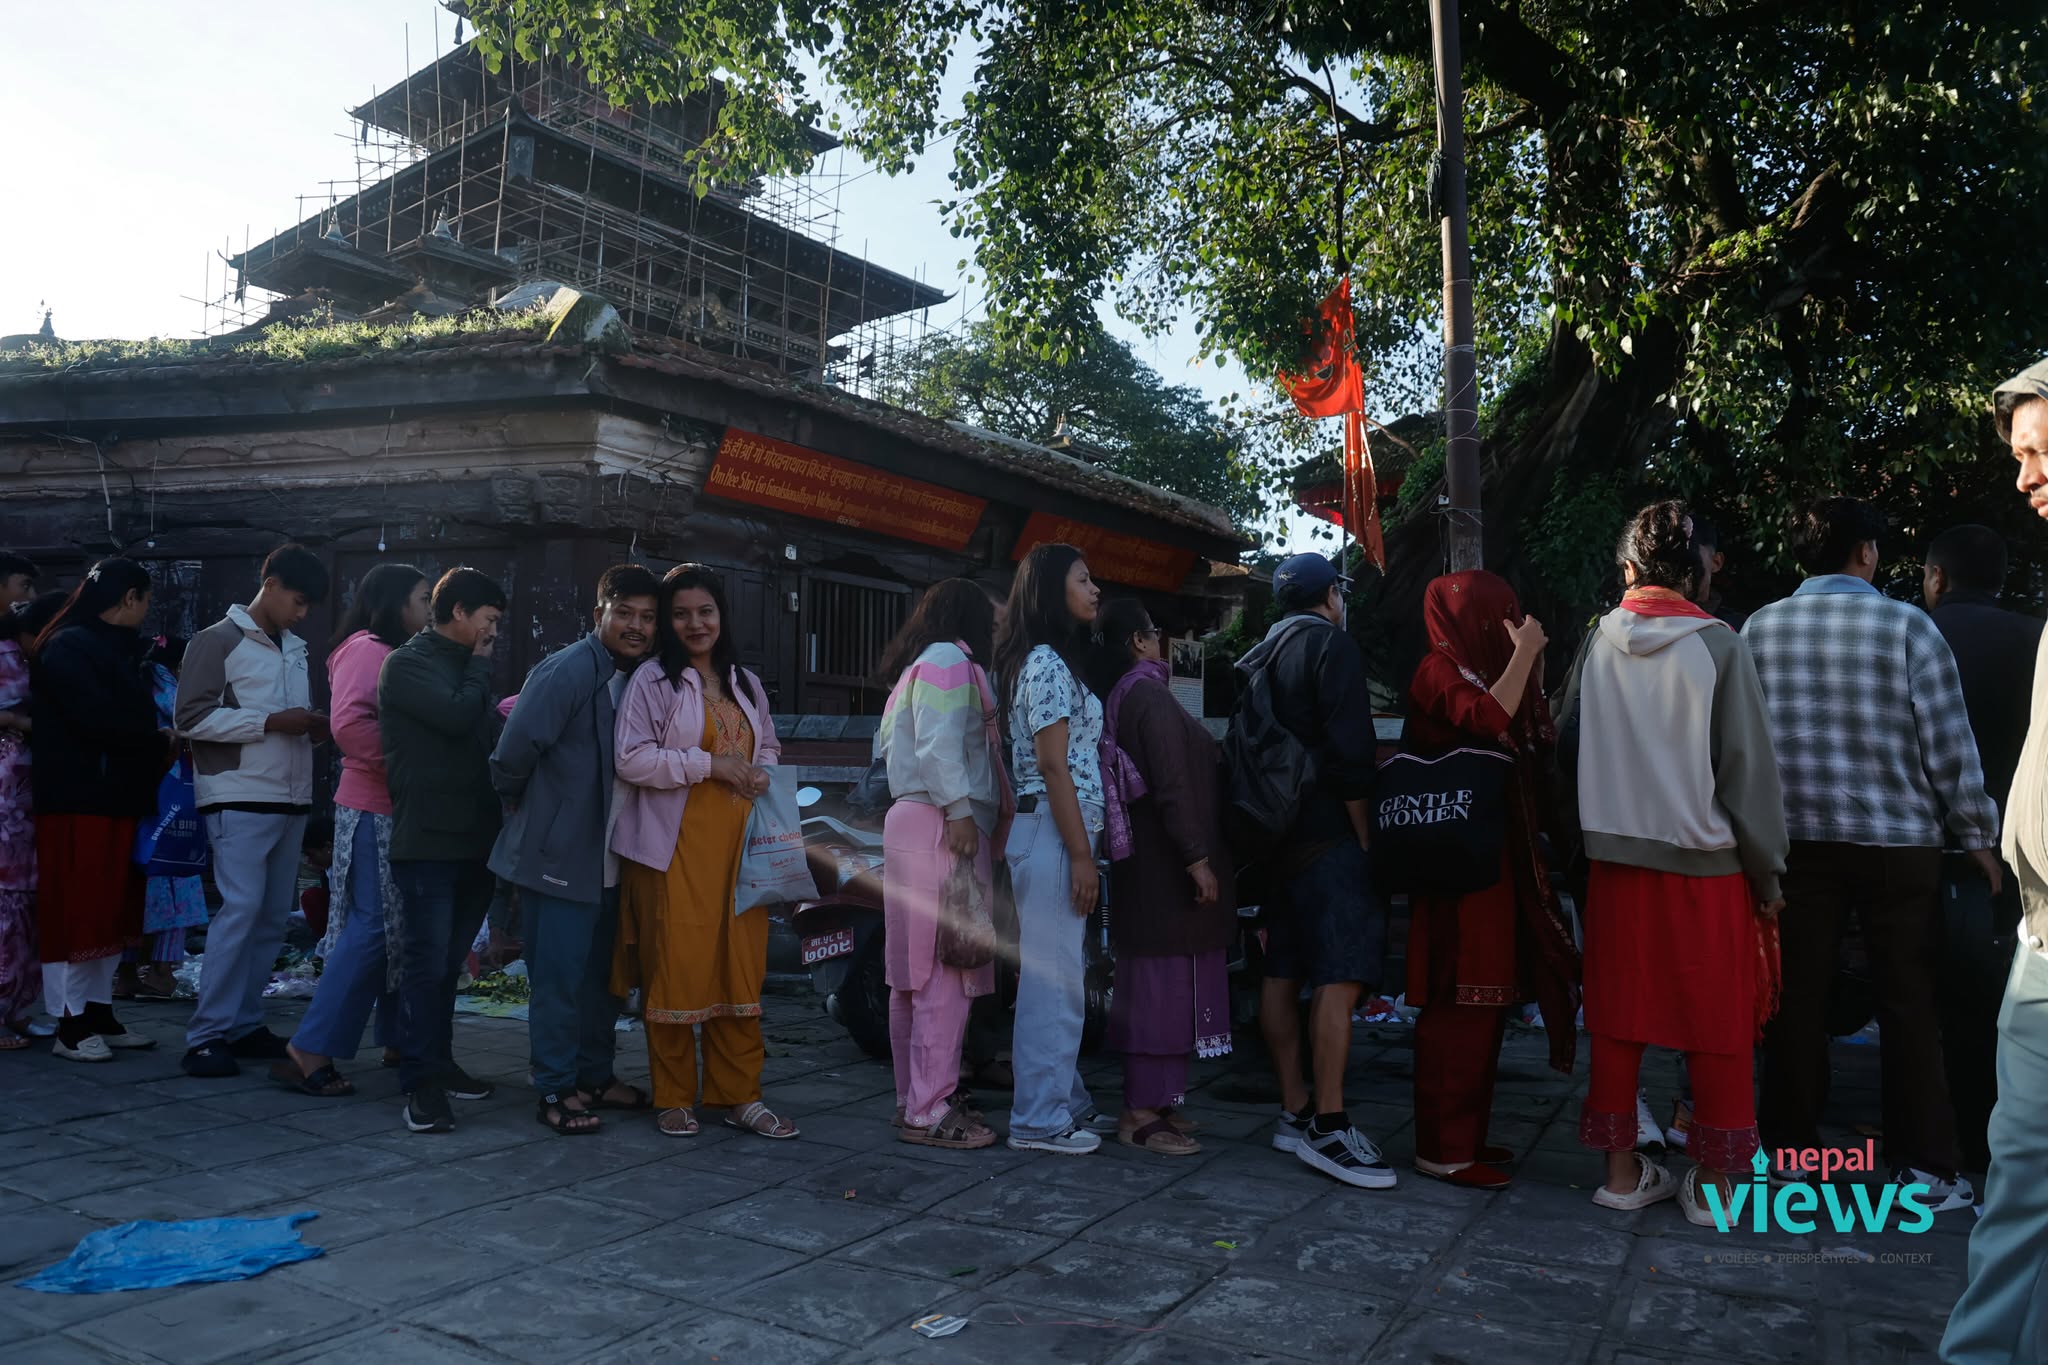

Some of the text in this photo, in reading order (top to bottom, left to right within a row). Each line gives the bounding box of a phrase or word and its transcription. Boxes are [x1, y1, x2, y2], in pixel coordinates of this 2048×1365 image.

[710, 463, 726, 486] Om
[723, 467, 740, 488] Hee
[739, 471, 757, 492] Shri
[1380, 789, 1473, 815] GENTLE
[1379, 804, 1470, 831] WOMEN
